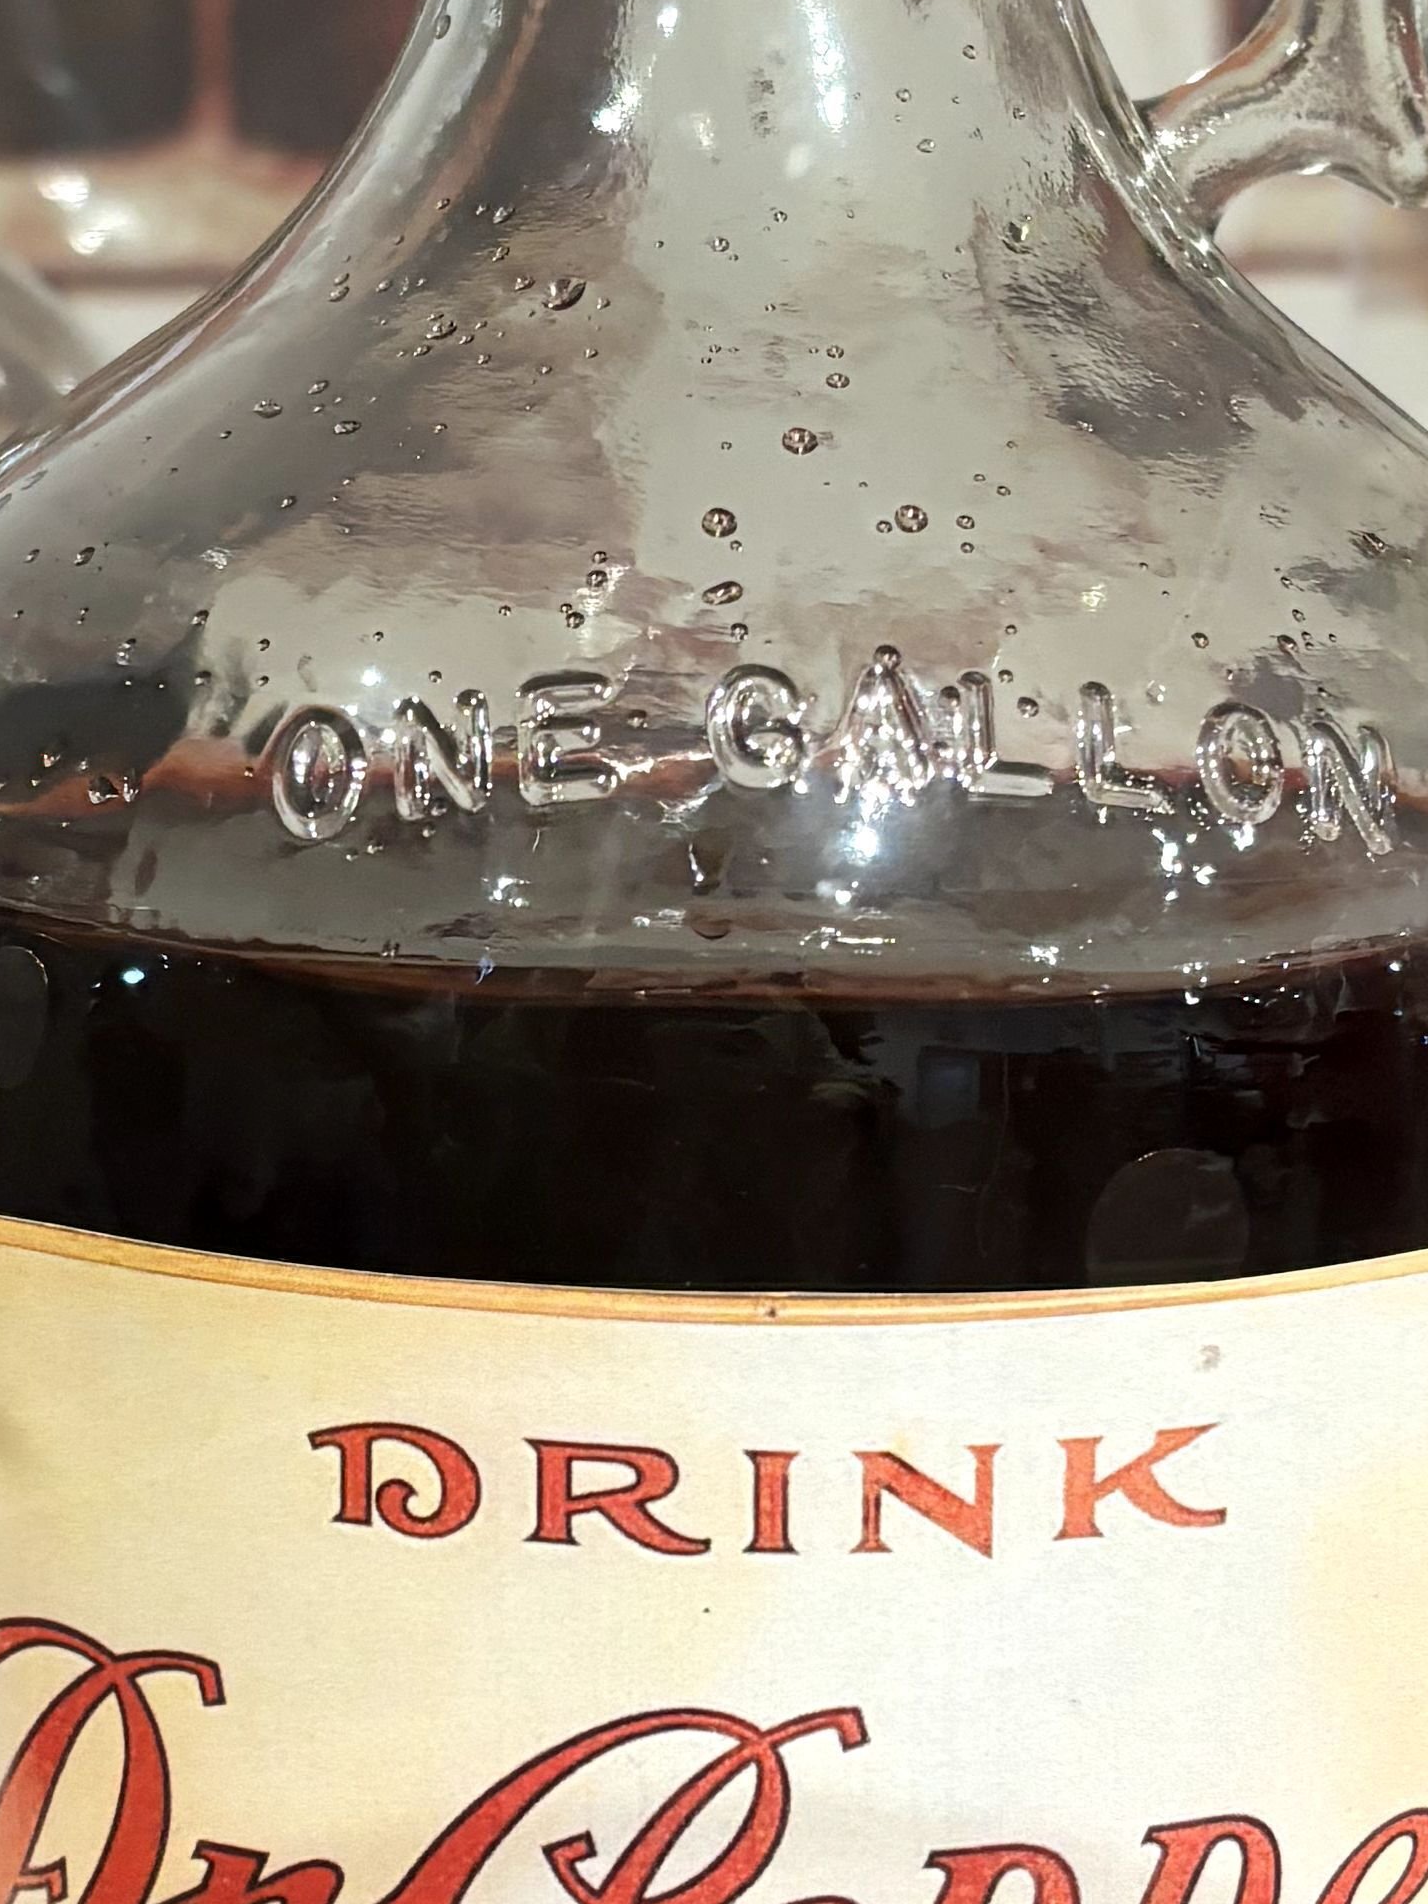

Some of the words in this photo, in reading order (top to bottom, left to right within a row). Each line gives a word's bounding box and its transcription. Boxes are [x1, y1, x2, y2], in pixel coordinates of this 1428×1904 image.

[268, 669, 622, 843] ONE
[701, 658, 1404, 856] GALLON
[308, 1421, 1228, 1559] DRINK
